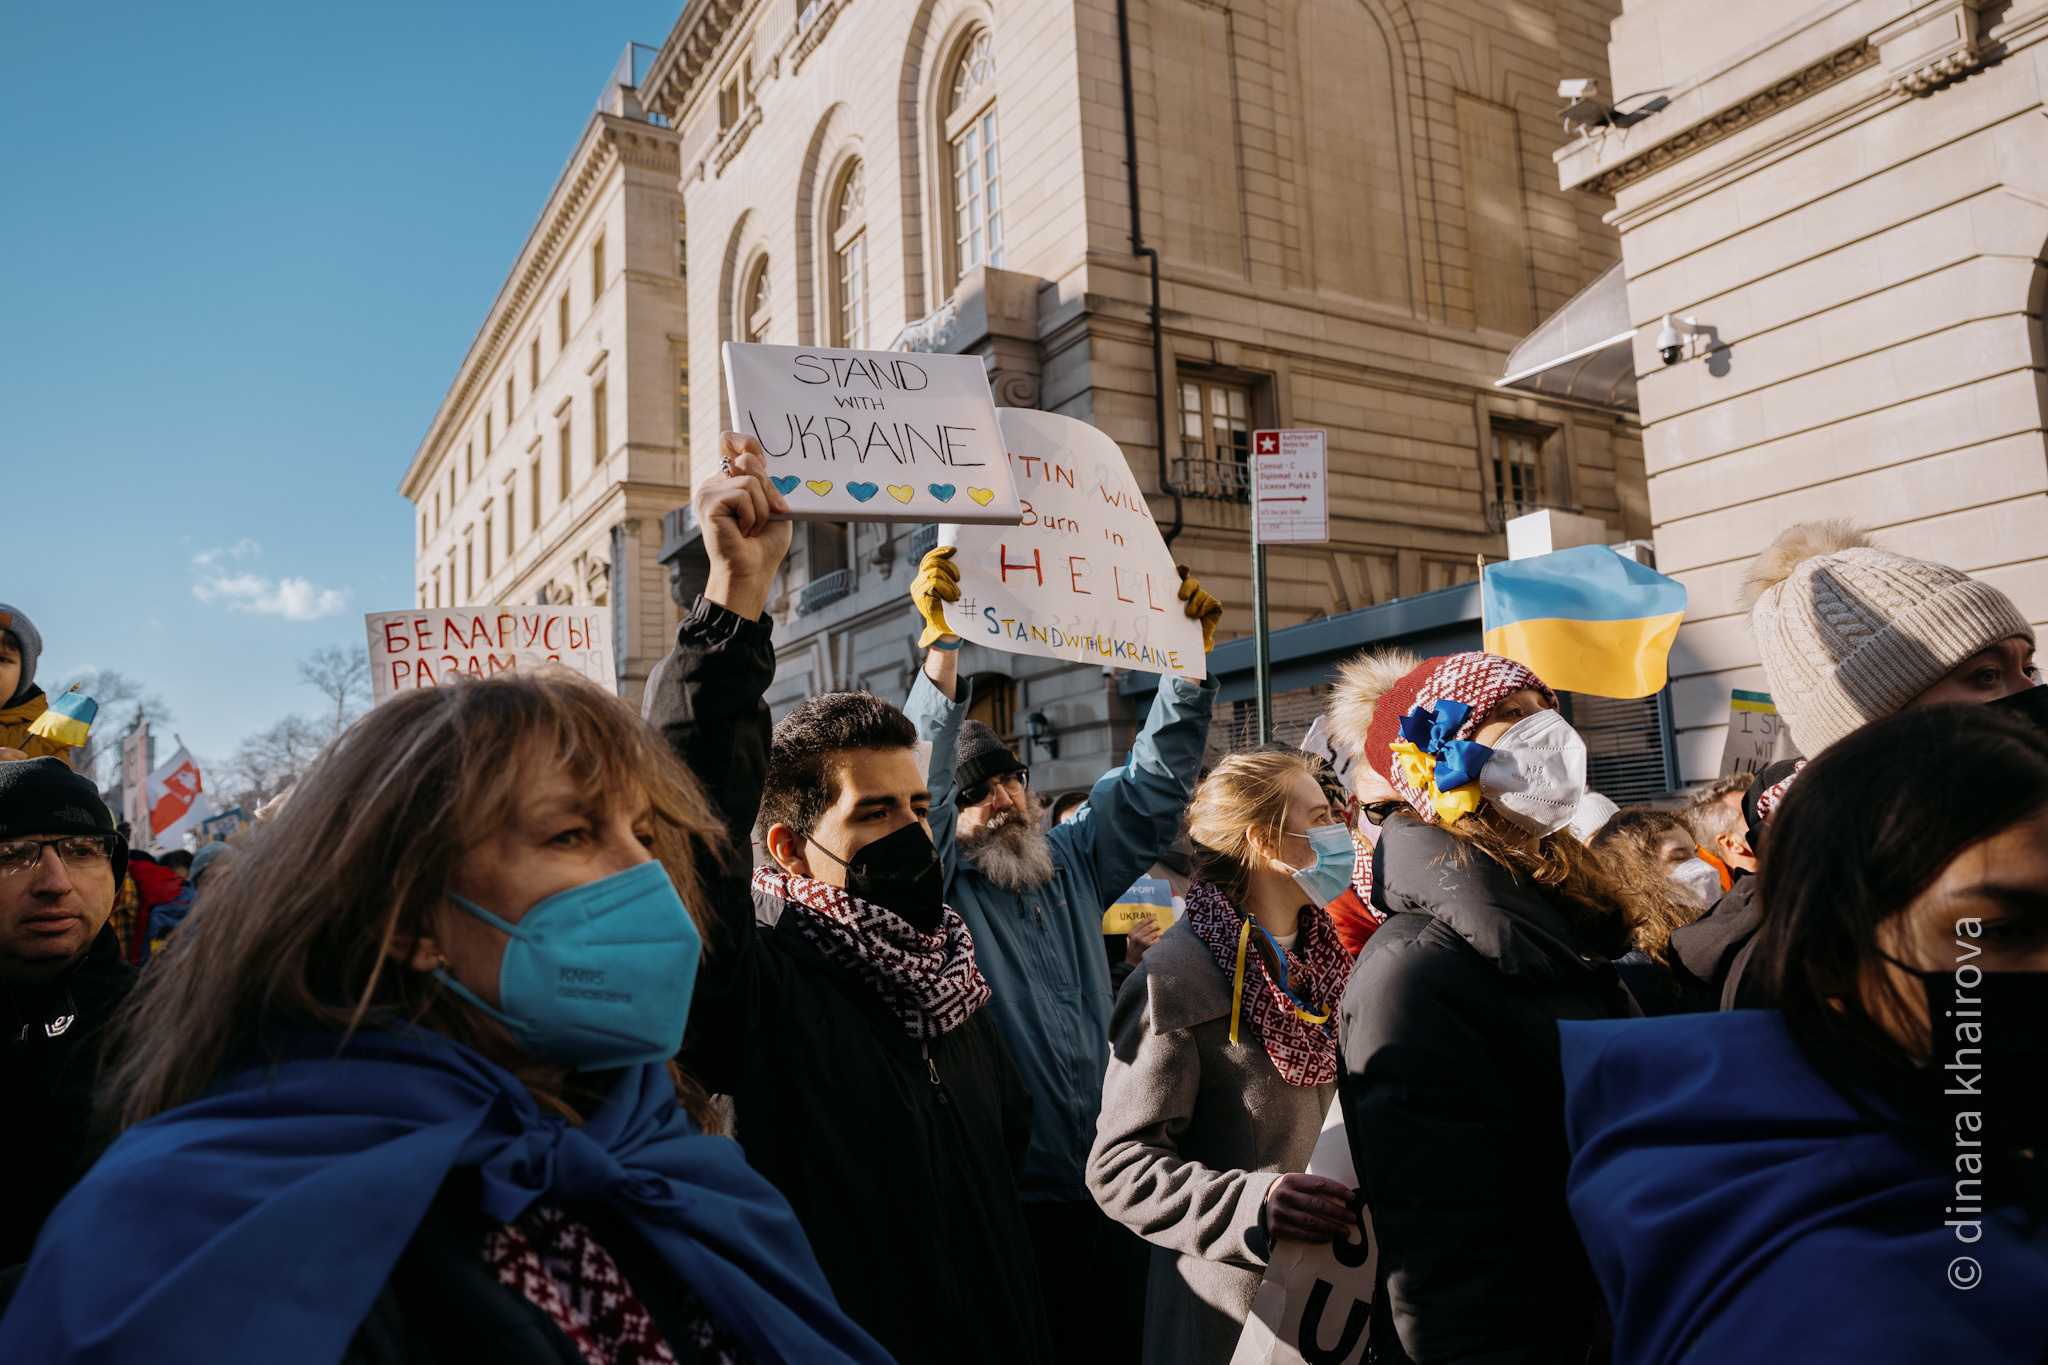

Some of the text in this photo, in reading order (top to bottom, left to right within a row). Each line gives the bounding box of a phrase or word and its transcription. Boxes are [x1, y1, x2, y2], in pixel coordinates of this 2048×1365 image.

[793, 354, 928, 391] STAND
[833, 395, 885, 410] WITH
[748, 410, 986, 466] UKRAINE
[1282, 448, 1297, 456] Only
[1260, 462, 1283, 470] Consul
[1260, 472, 1291, 480] Diplomat
[1008, 453, 1074, 488] TIN
[1100, 485, 1149, 518] WILL
[1260, 481, 1311, 490] License Plates
[1105, 529, 1124, 547] in
[1001, 544, 1164, 612] HELL
[385, 613, 591, 654] БЕЛАРУСЫ
[1739, 711, 1786, 735] I STA
[1754, 741, 1775, 759] WIT
[1127, 886, 1155, 895] PPORT
